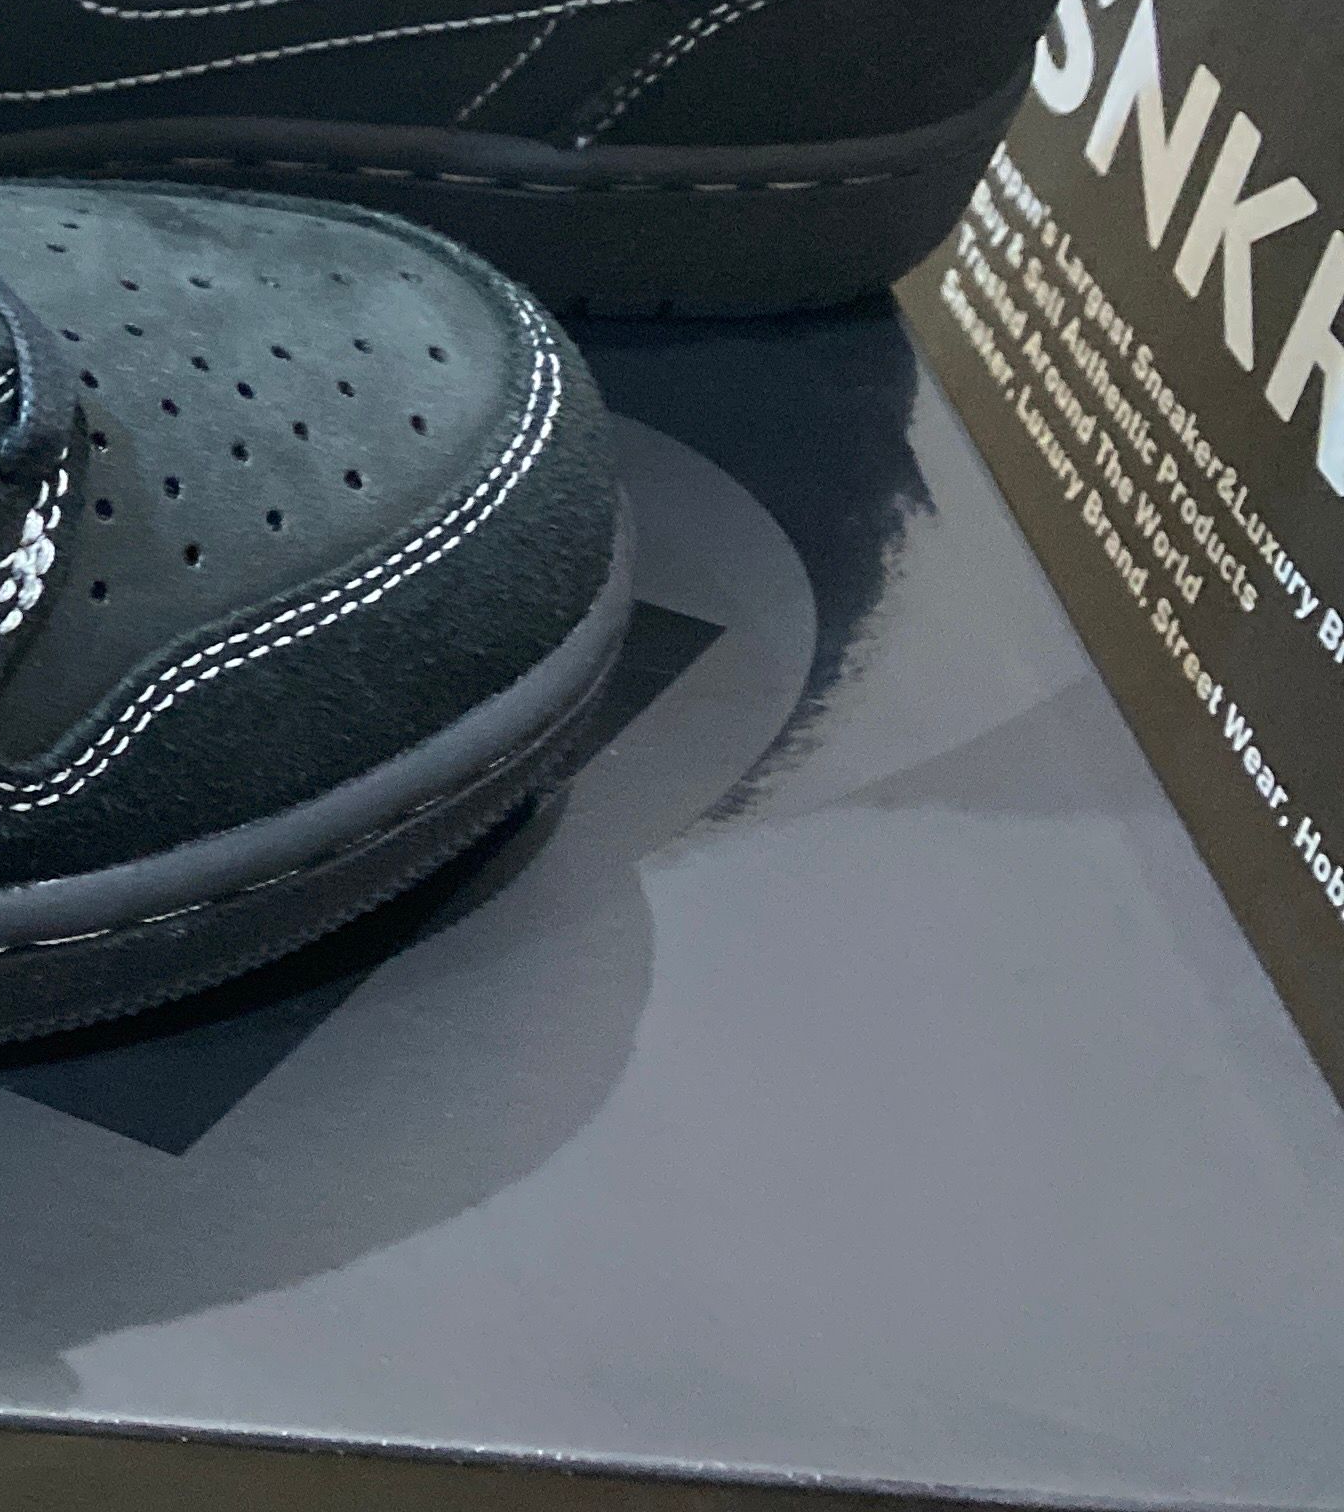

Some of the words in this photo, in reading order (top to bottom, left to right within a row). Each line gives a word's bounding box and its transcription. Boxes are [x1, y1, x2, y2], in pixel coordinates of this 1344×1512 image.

[957, 223, 1029, 339] Trusted
[1022, 331, 1097, 444] Around
[1096, 430, 1134, 504] The
[1134, 491, 1204, 605] World
[971, 178, 1010, 247] Buy
[1005, 232, 1025, 268] &
[1023, 257, 1065, 328] Sell
[1060, 316, 1158, 466] Authentic
[1156, 453, 1259, 612] Products
[1016, 384, 1085, 501] Luxury
[1151, 598, 1224, 715] Street
[1056, 233, 1134, 357] Largest
[1131, 344, 1319, 619] Sneaker&Luxury
